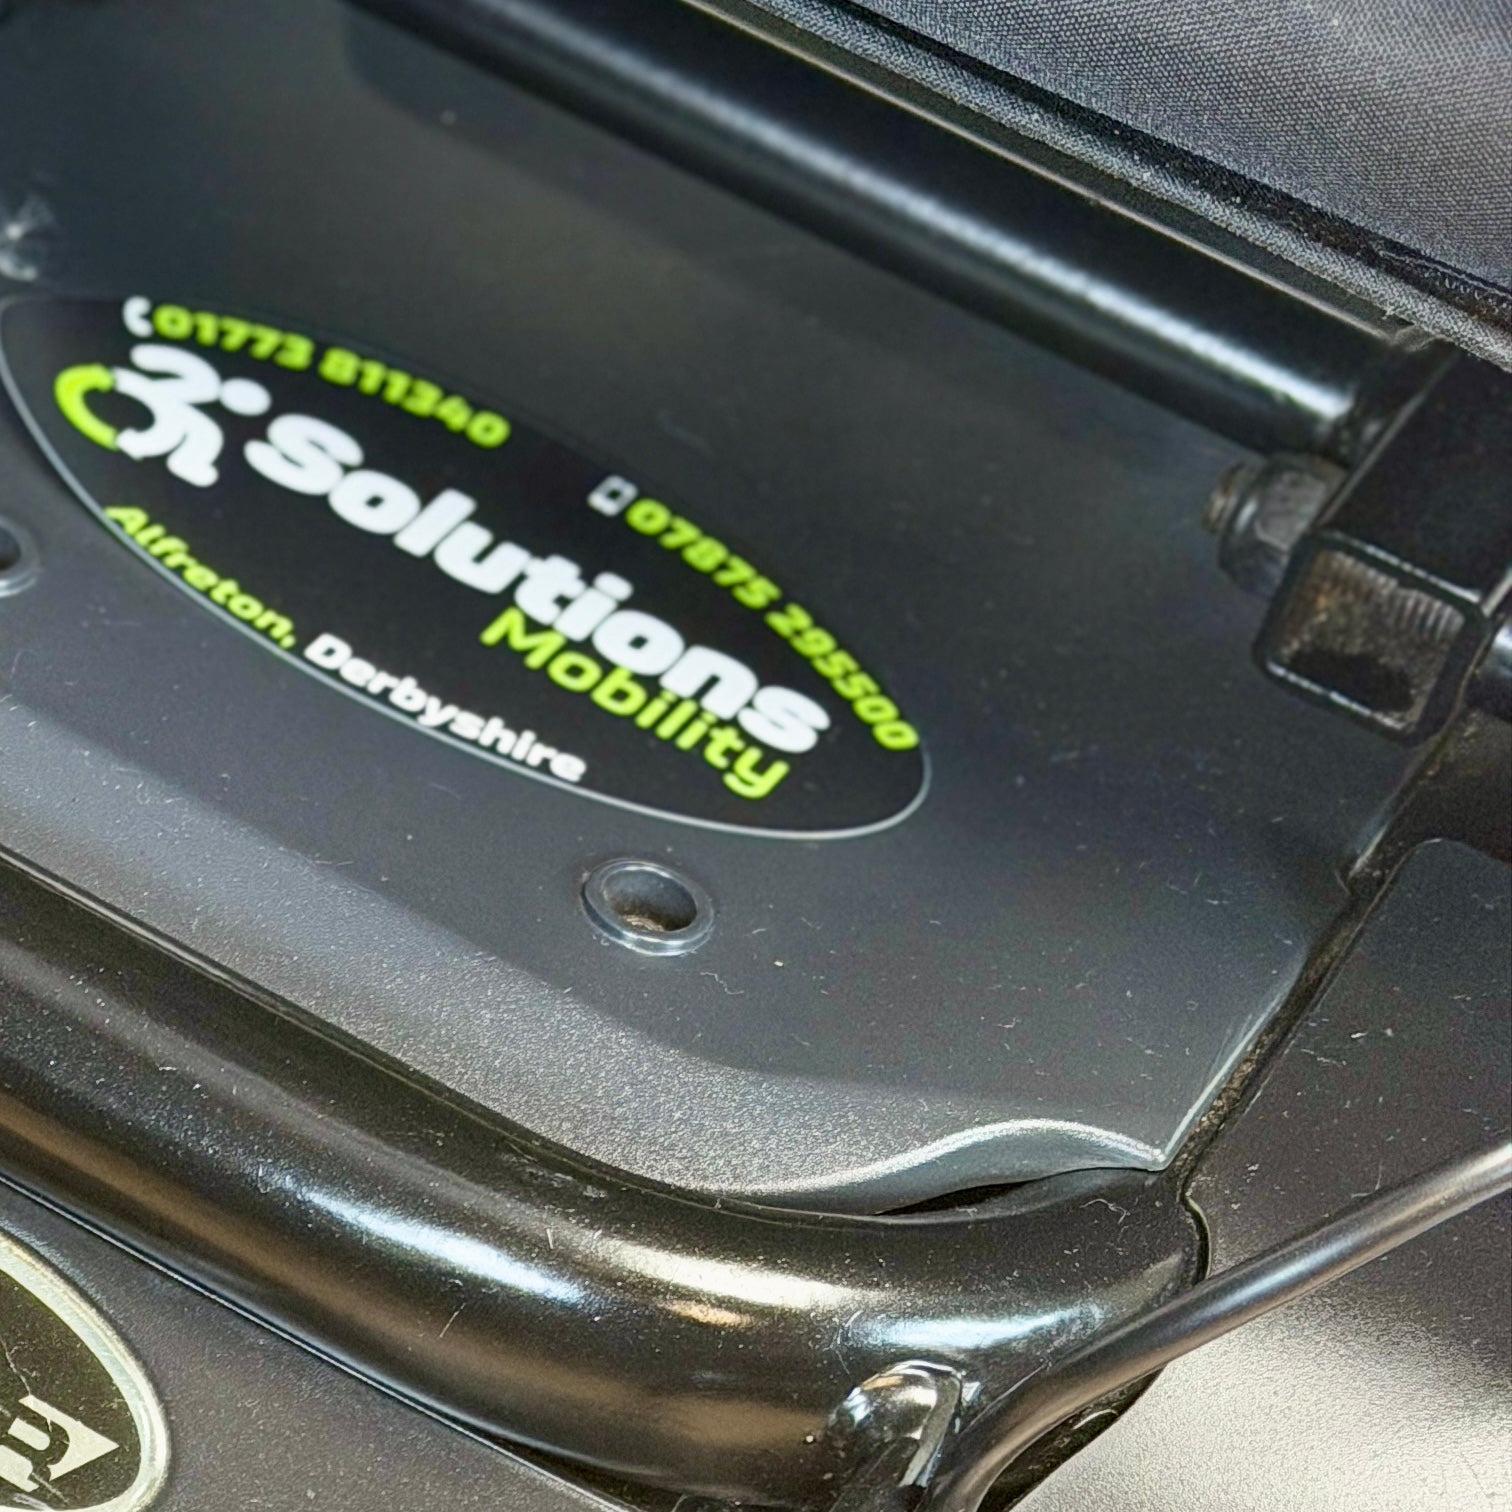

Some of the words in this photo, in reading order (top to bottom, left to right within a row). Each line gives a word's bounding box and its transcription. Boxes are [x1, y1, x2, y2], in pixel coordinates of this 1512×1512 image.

[151, 304, 316, 370] 01773
[244, 414, 830, 753] Solutions
[626, 498, 781, 609] 07875
[765, 603, 919, 750] 295500
[304, 633, 586, 783] Derbyshire
[479, 604, 791, 800] Mobility
